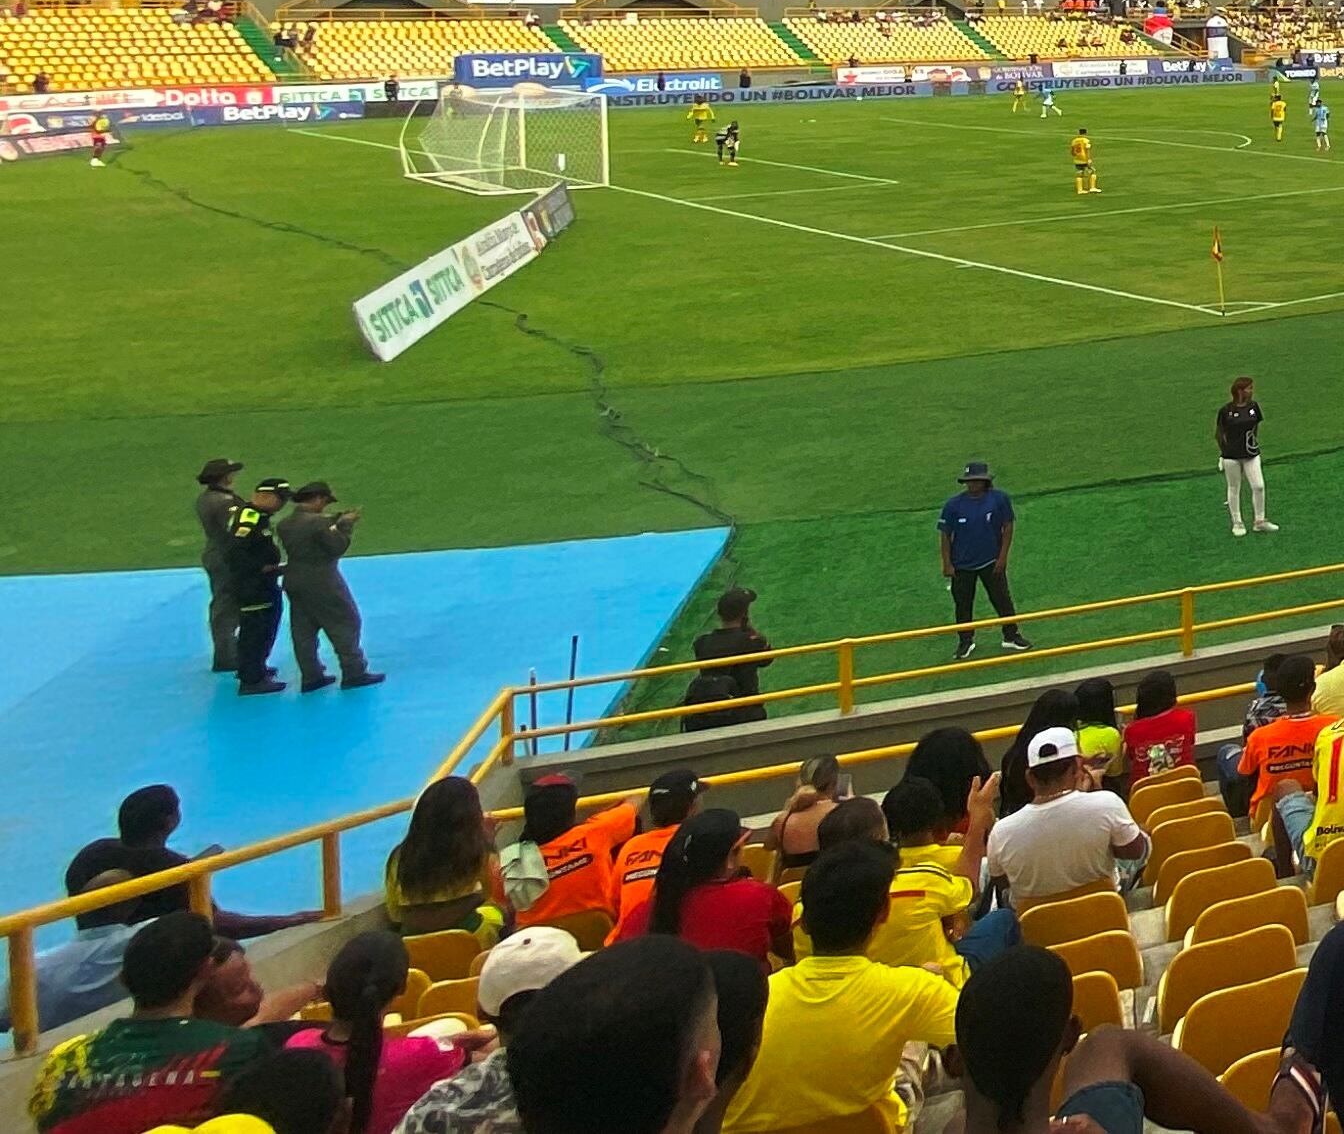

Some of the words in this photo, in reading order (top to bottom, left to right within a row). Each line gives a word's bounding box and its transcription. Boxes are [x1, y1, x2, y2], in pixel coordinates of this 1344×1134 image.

[472, 56, 564, 78] BetPlay
[1163, 60, 1206, 73] BetPay
[635, 76, 722, 92] Elctrolit
[1114, 76, 1134, 86] UN
[1202, 72, 1243, 83] MEJOR
[281, 91, 342, 103] SITTCA
[372, 87, 431, 99] STCA
[740, 89, 767, 102] UN
[861, 85, 917, 98] MEJOR
[223, 105, 311, 122] BetPlay
